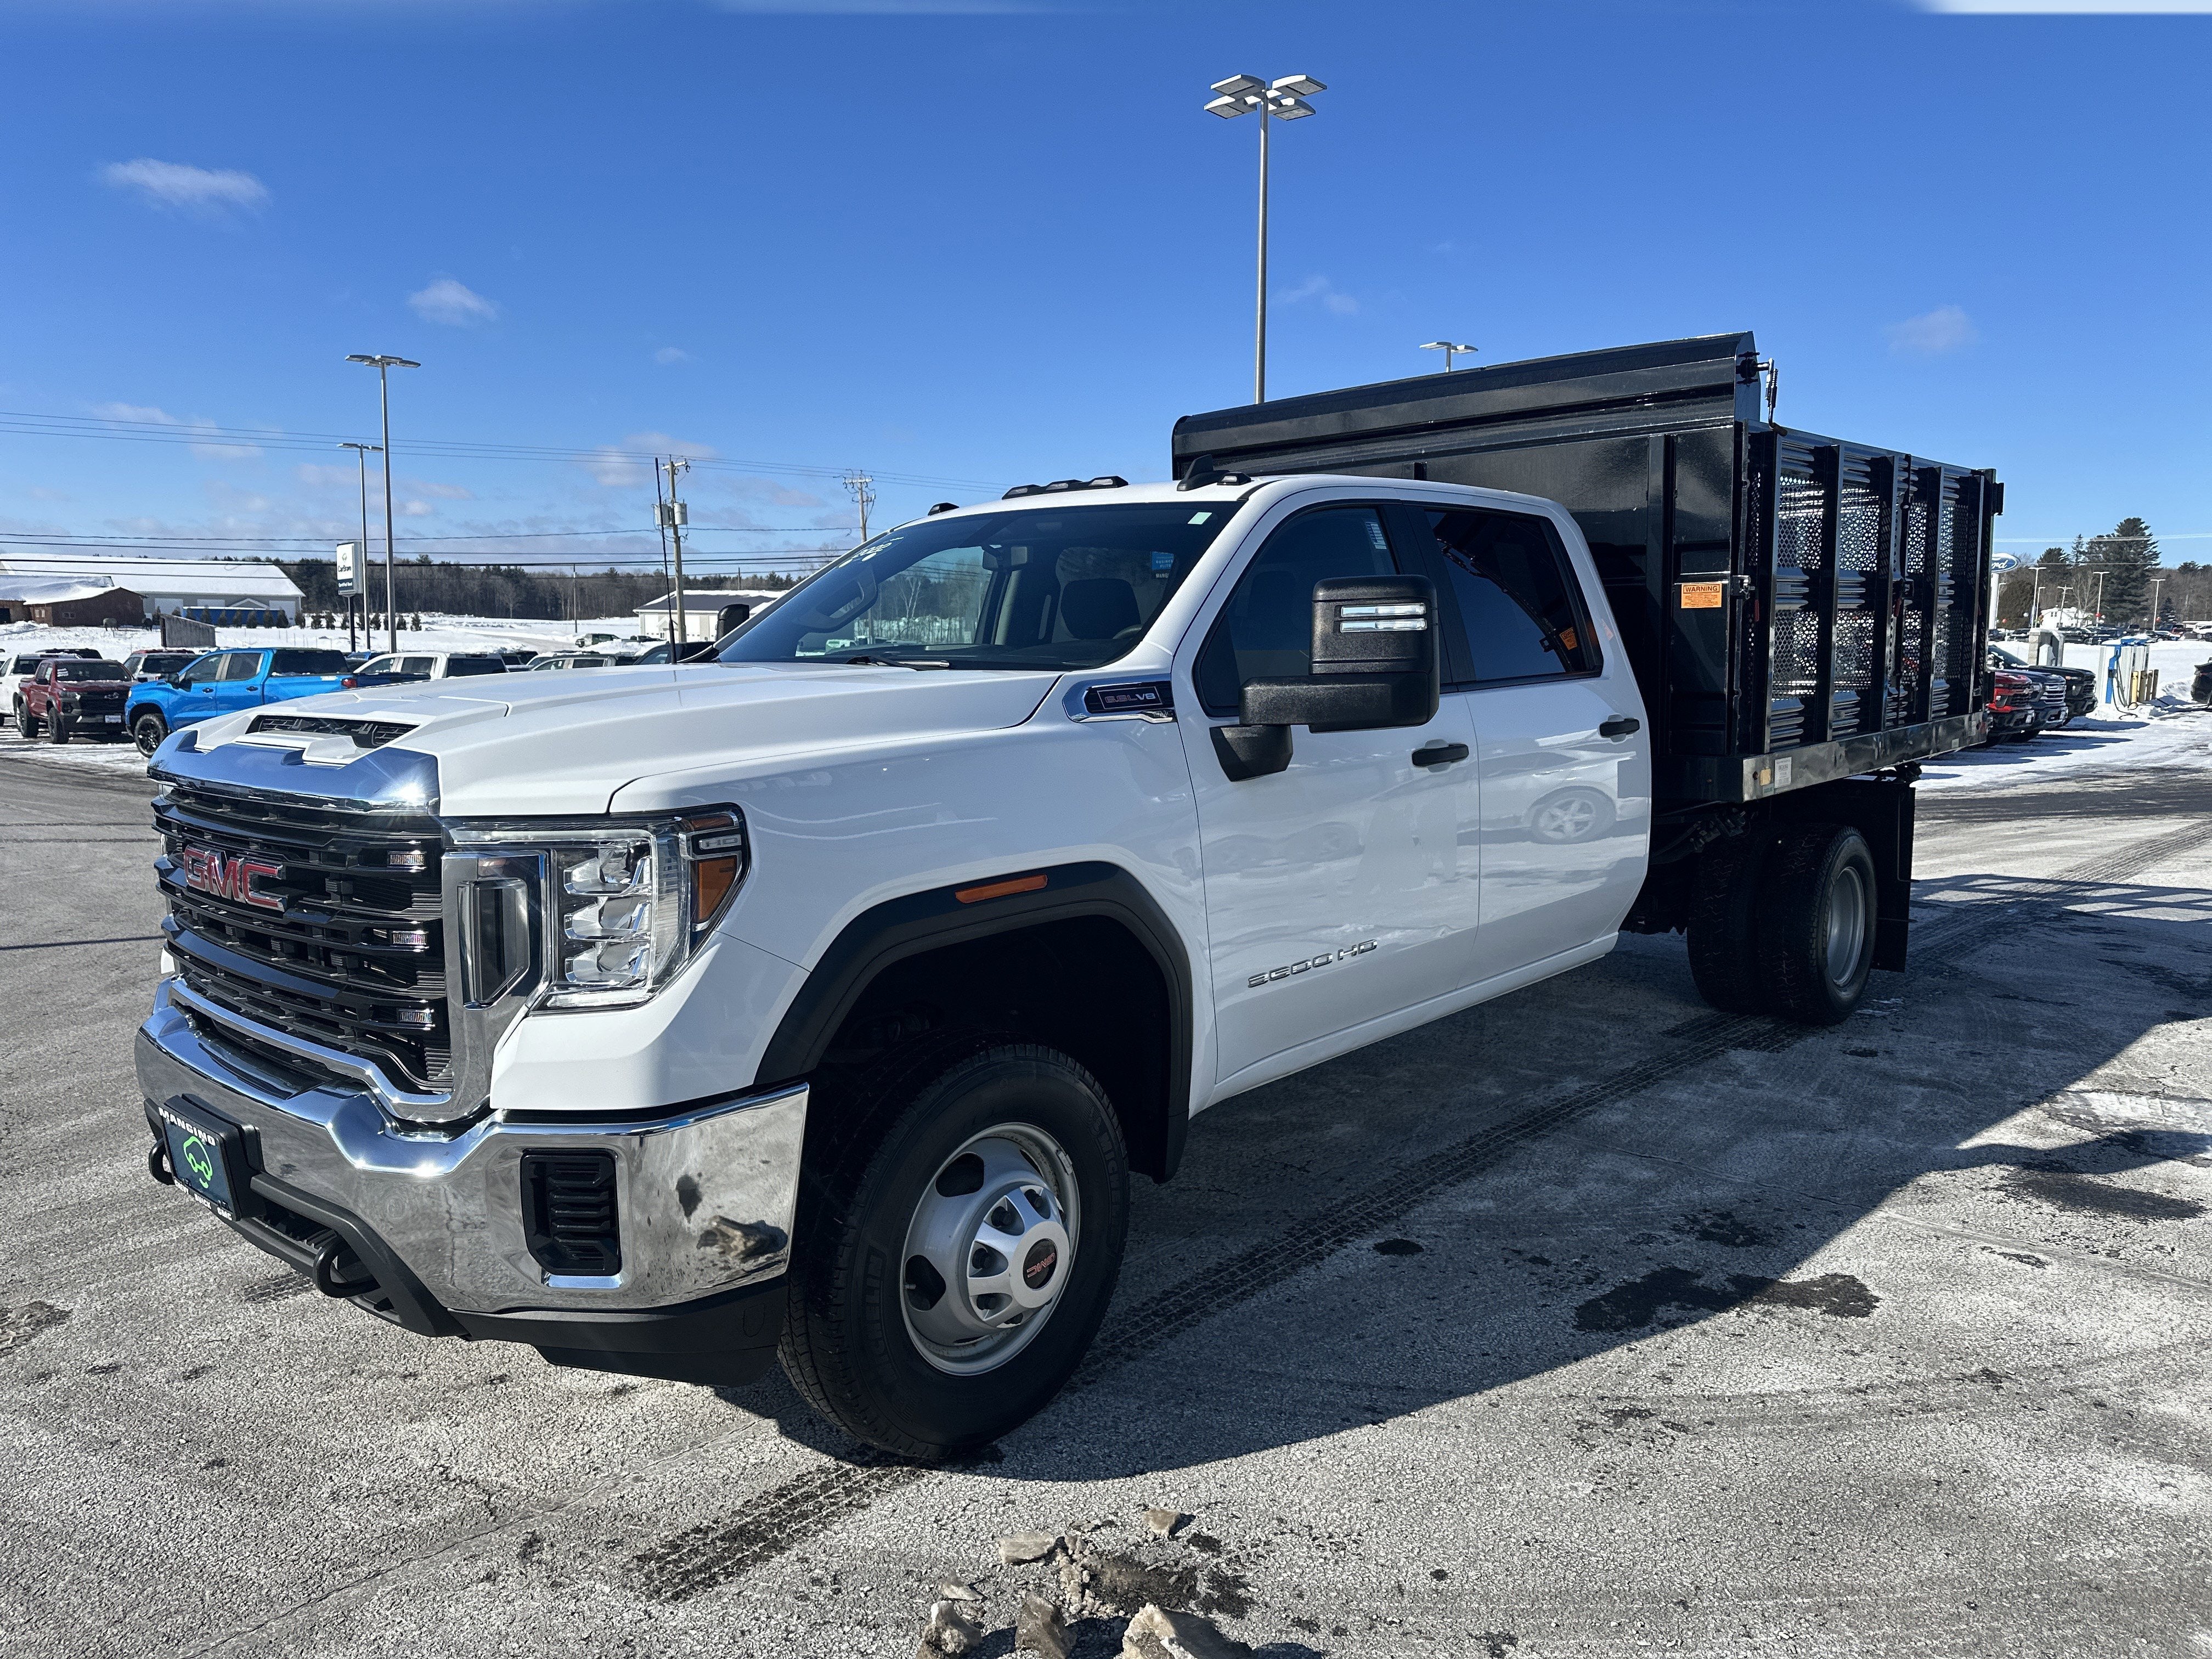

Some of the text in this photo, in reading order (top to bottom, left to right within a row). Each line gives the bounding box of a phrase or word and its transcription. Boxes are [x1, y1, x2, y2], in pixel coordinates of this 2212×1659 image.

[1992, 558, 2008, 569] rd
[184, 845, 286, 912] GMC
[1338, 939, 1378, 961] HD
[158, 1107, 216, 1146] MANGINO
[194, 1193, 212, 1210] BUICK
[217, 1207, 233, 1221] GMC
[1026, 1252, 1056, 1278] GMC
